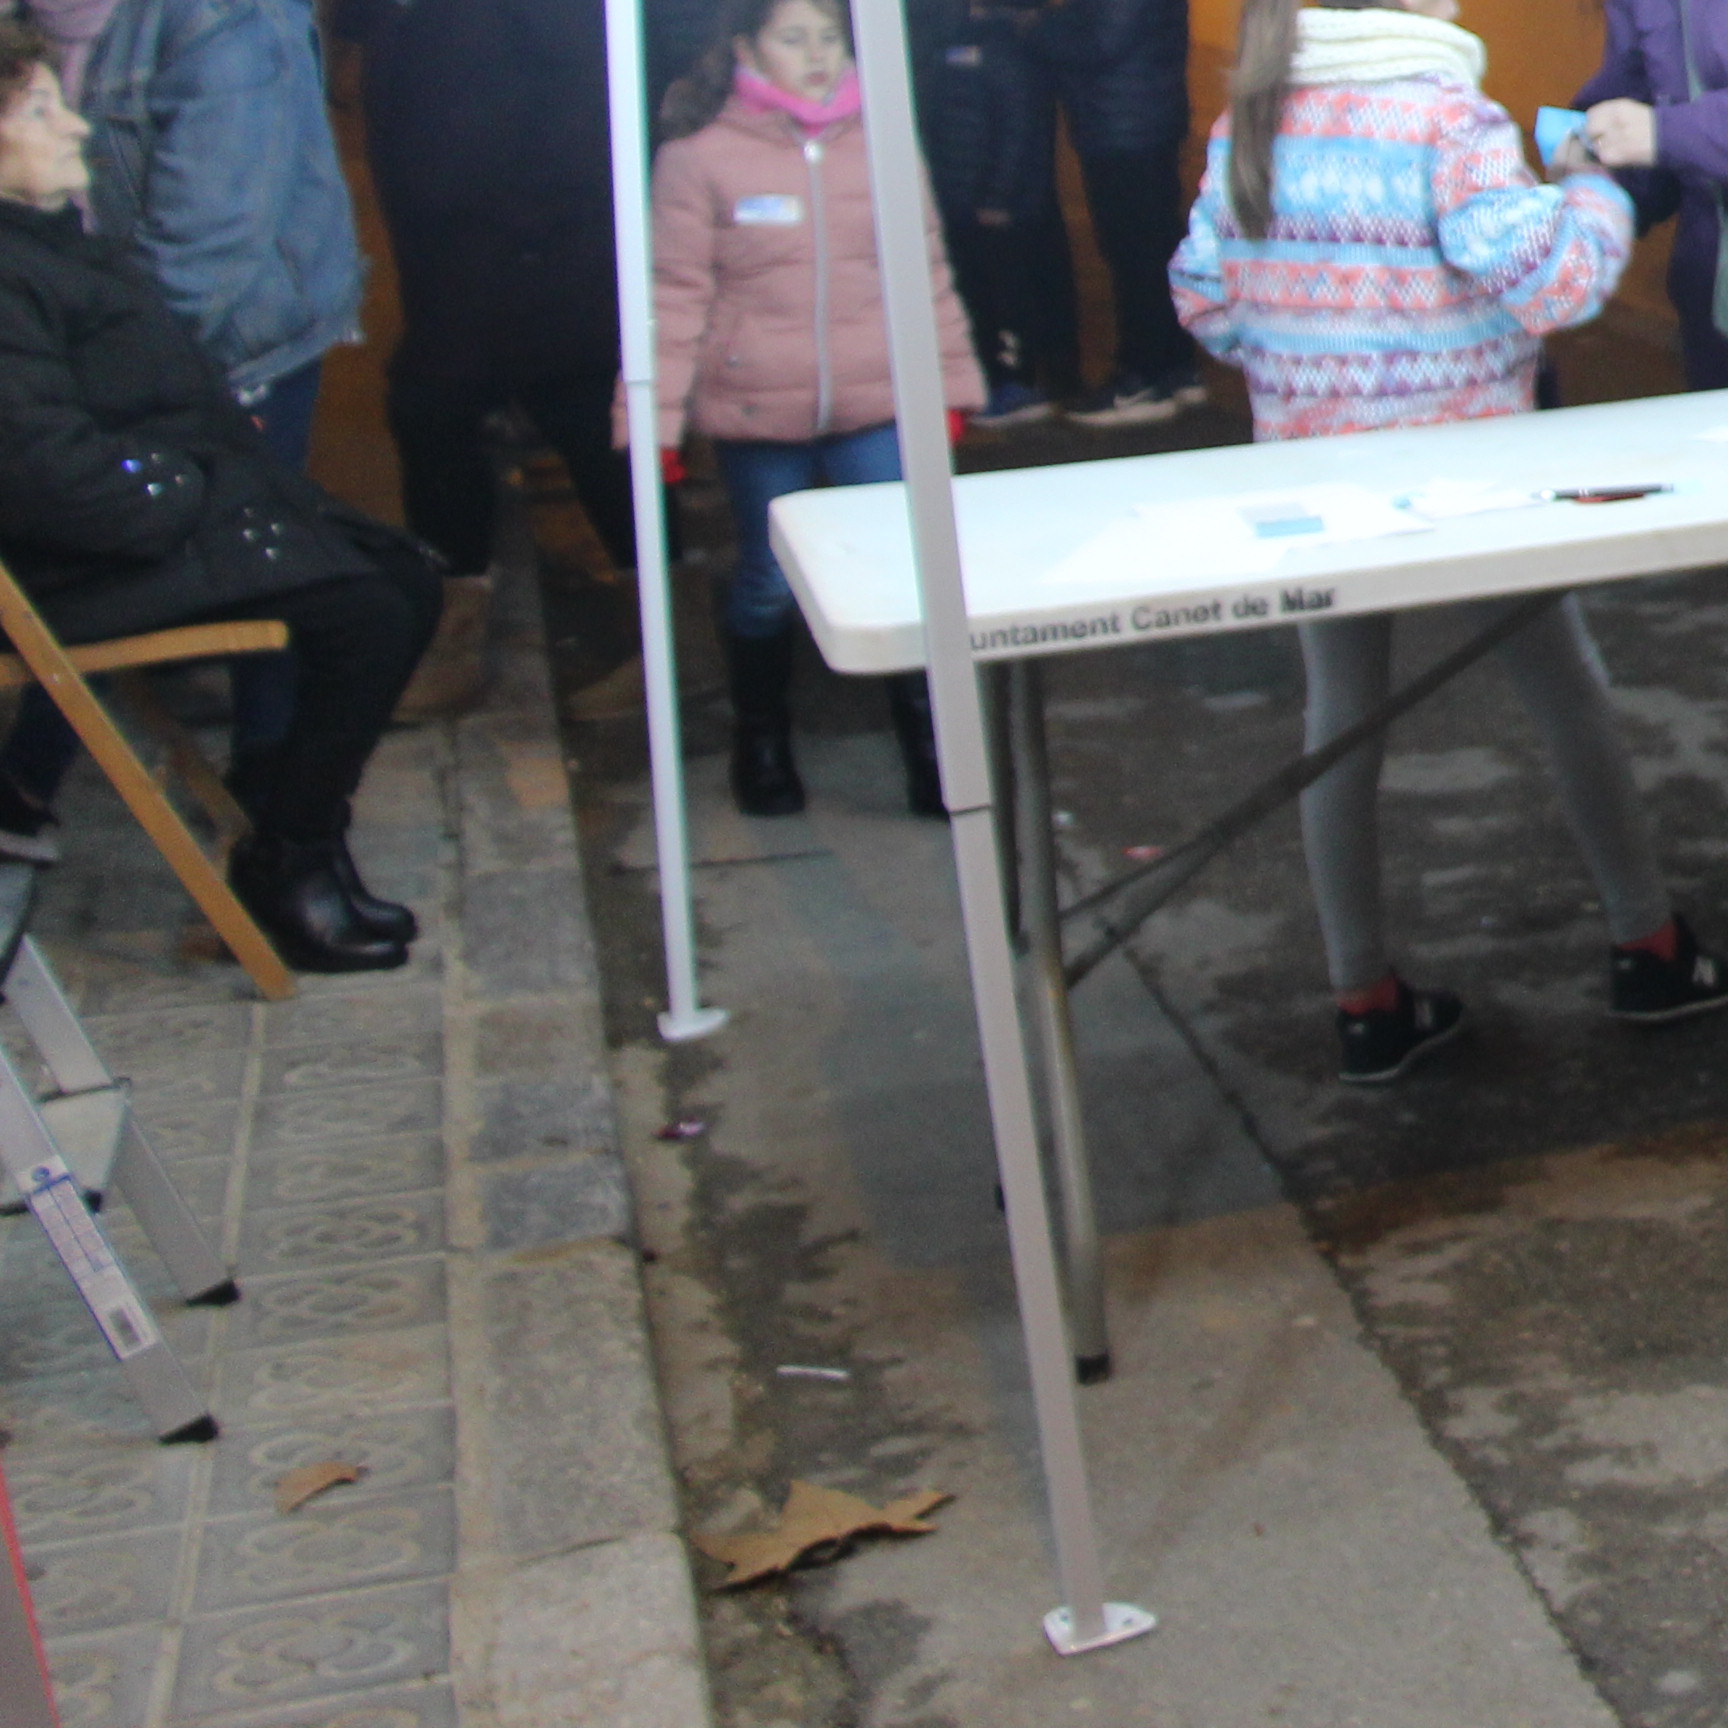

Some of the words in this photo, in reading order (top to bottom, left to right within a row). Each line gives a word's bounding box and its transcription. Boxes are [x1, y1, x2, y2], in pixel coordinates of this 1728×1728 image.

[970, 613, 1121, 651] untament
[1130, 598, 1222, 632] Canet
[1232, 593, 1268, 619] de
[1280, 586, 1335, 613] Mar
